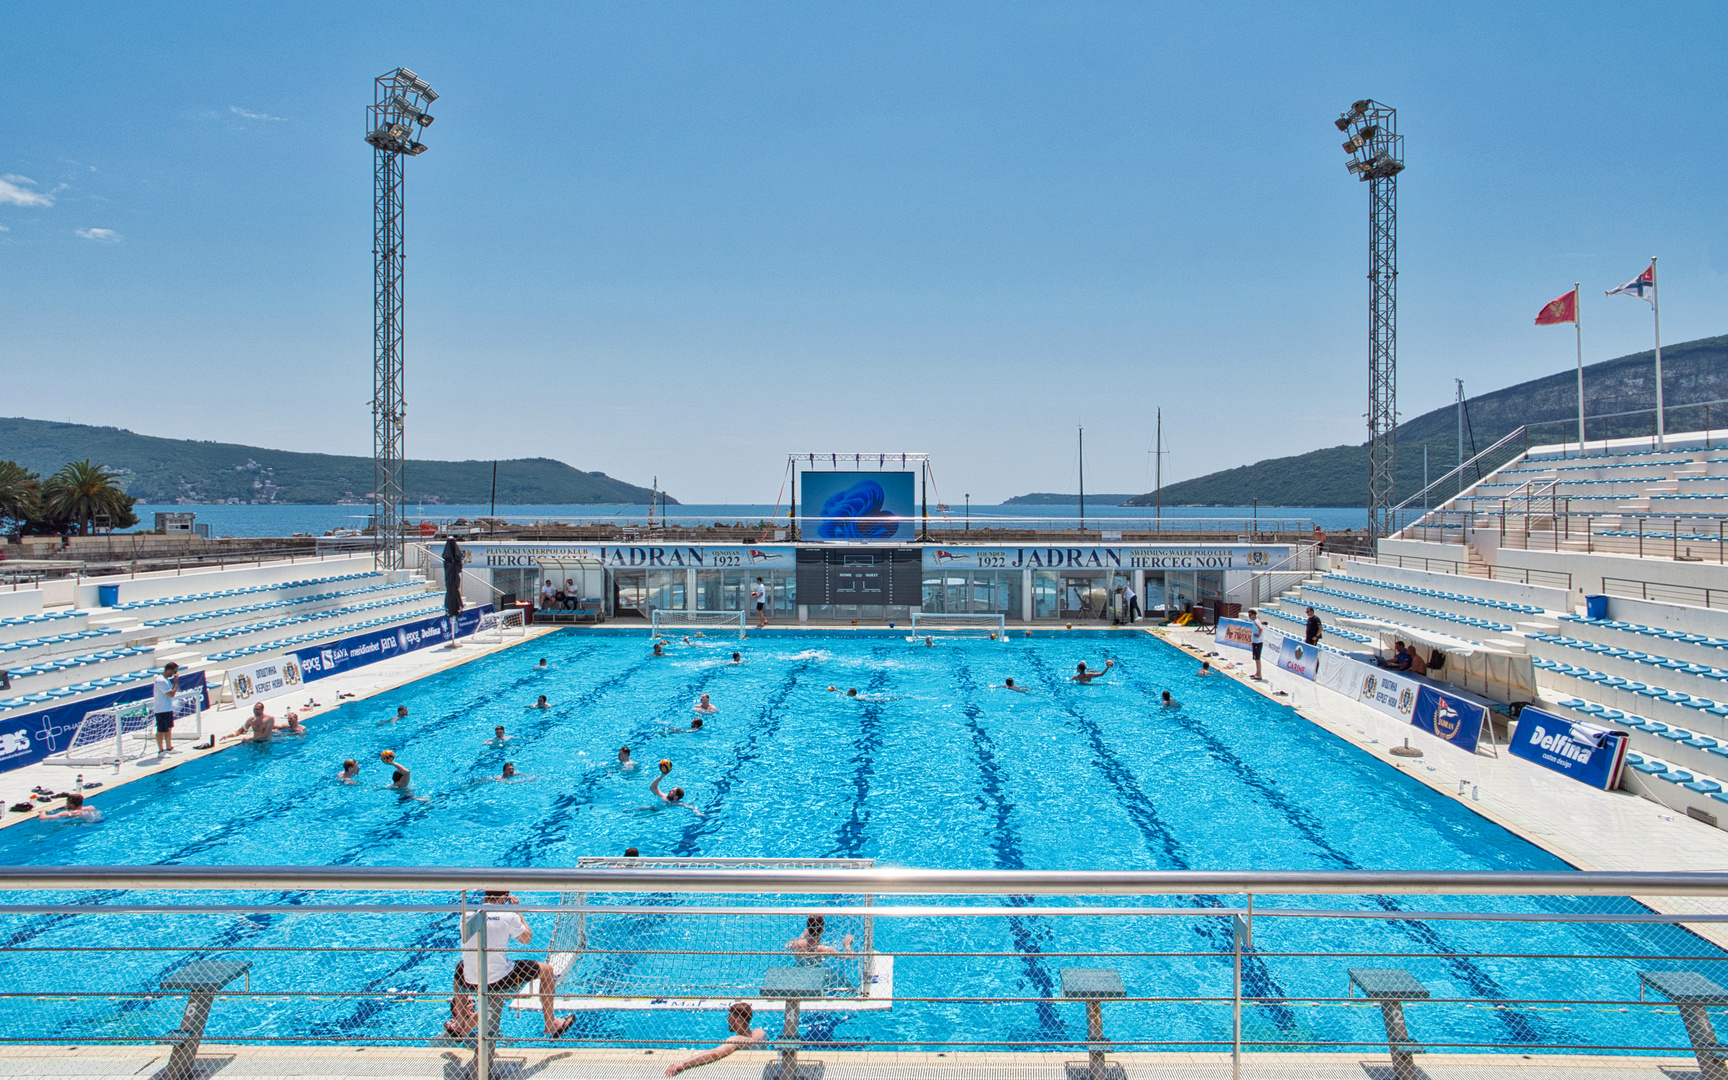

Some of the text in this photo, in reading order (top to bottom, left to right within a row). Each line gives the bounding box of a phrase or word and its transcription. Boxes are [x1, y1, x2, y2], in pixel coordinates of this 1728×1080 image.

[600, 547, 705, 567] JADRAN
[713, 556, 740, 567] 1922
[978, 557, 1005, 567] 1922
[1012, 548, 1122, 567] JADRAN
[1130, 556, 1233, 568] HERCEG NOVI
[405, 630, 421, 645] epcg
[421, 627, 441, 639] Delfina
[350, 642, 380, 658] meridianbet
[302, 656, 321, 673] epcg
[1529, 725, 1593, 765] Delfina
[1542, 753, 1572, 769] custom design
[186, 1003, 198, 1016] 6
[786, 1010, 796, 1022] 4
[1392, 1010, 1404, 1023] 2
